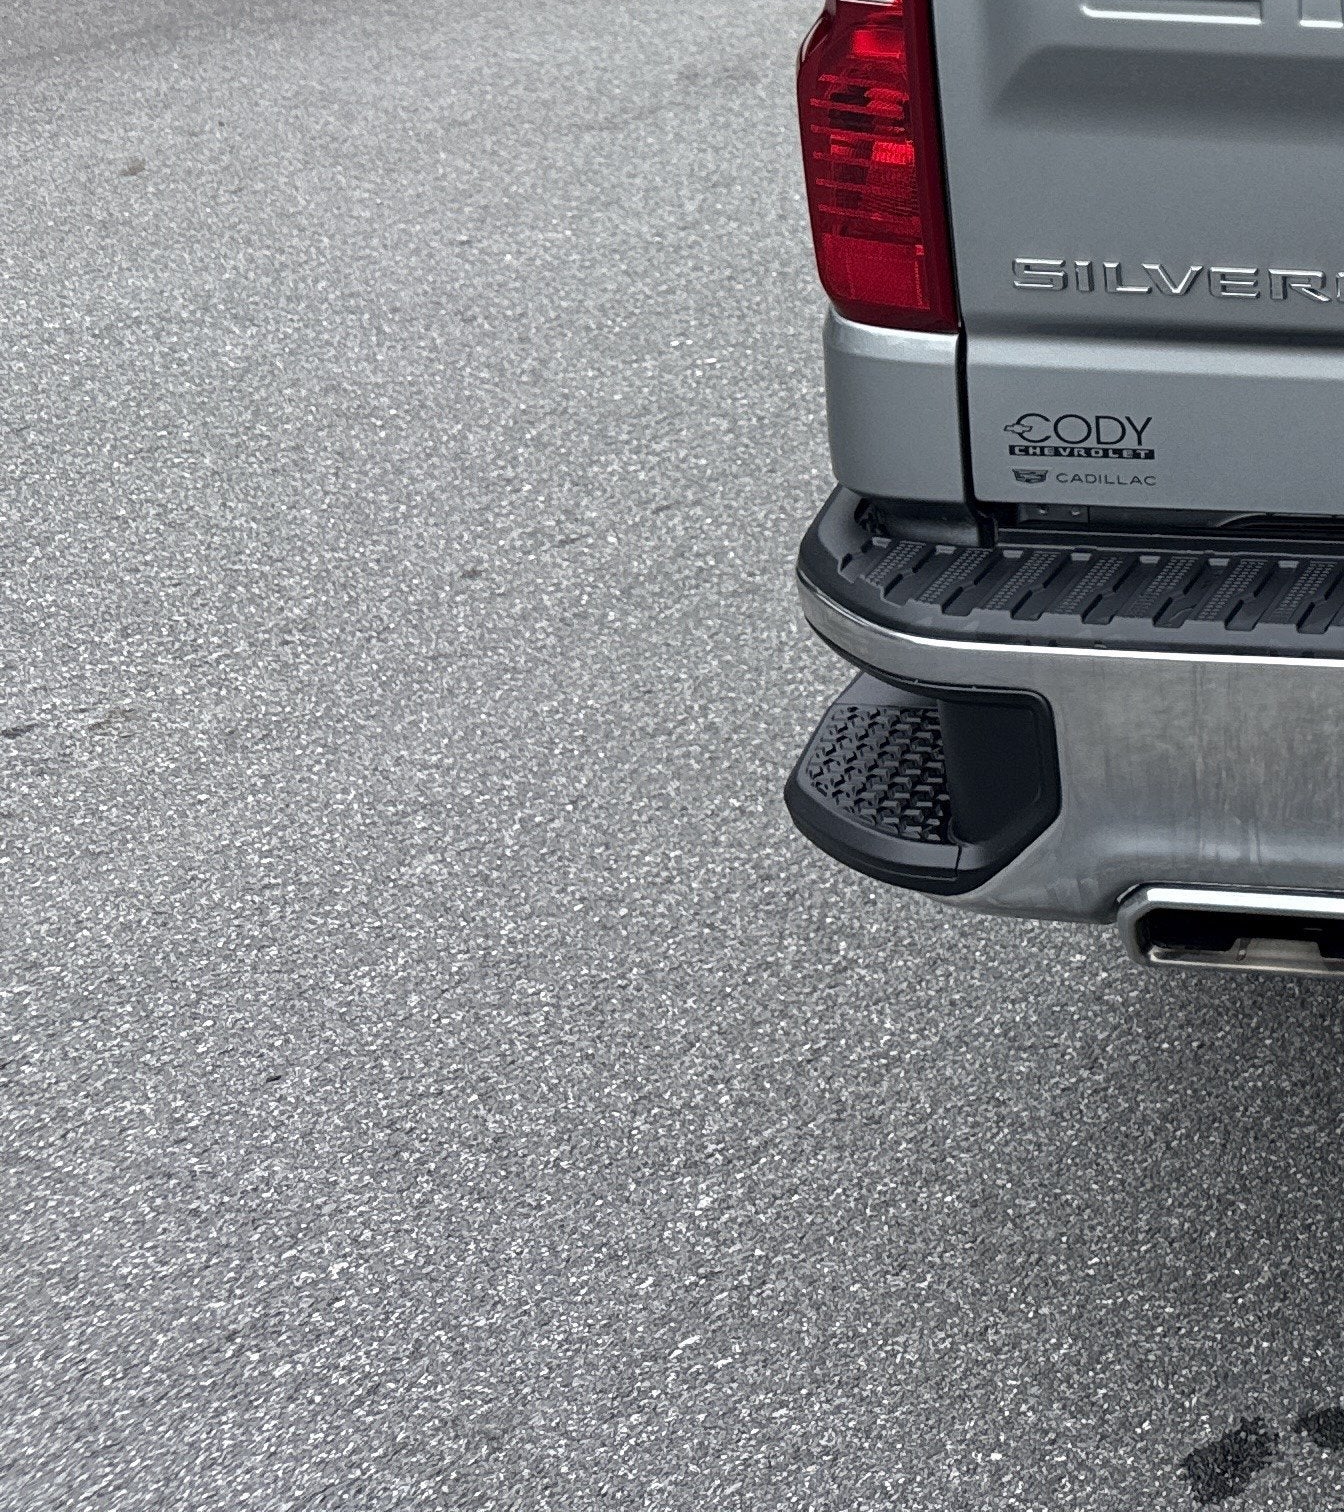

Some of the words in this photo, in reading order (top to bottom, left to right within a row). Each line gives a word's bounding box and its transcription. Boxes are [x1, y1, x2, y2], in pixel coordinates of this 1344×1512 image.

[1013, 412, 1153, 447] CODY
[1013, 445, 1151, 459] CHEVROLET
[1056, 472, 1157, 486] CADILLAC
